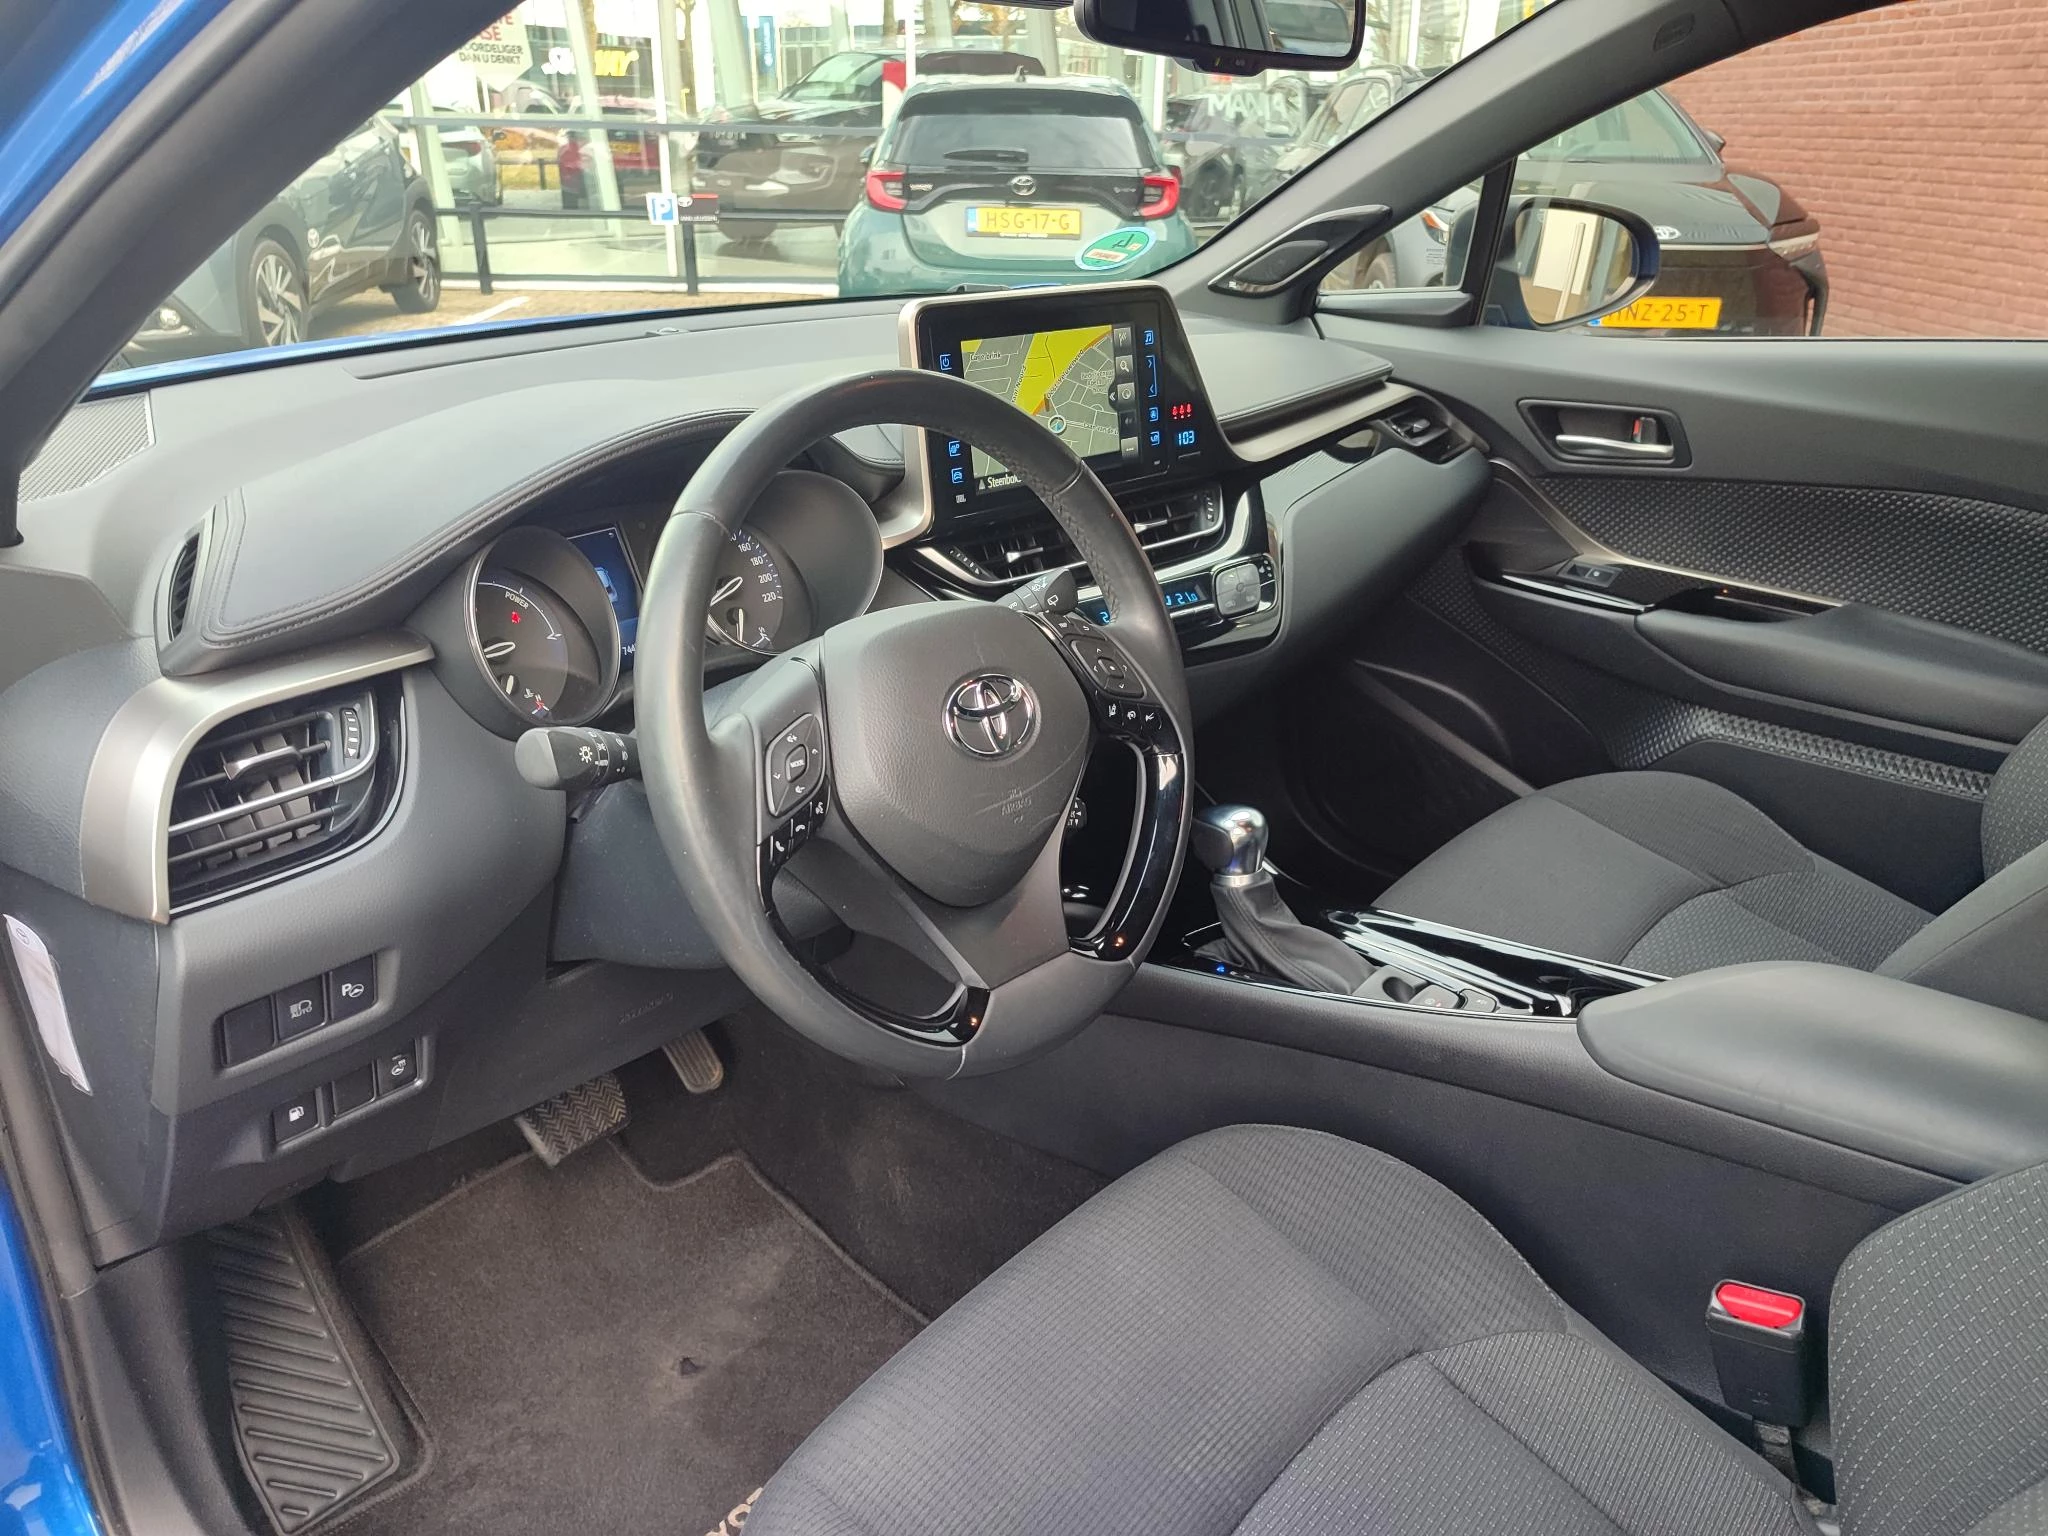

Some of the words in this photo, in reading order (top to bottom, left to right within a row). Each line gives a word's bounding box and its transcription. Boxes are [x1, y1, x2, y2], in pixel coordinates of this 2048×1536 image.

[986, 212, 1071, 231] HSG-17-G
[1177, 430, 1195, 446] 103
[737, 542, 752, 553] 160
[750, 555, 764, 567] 180
[758, 572, 773, 584] 200
[504, 591, 529, 610] POWER
[762, 590, 777, 603] 220
